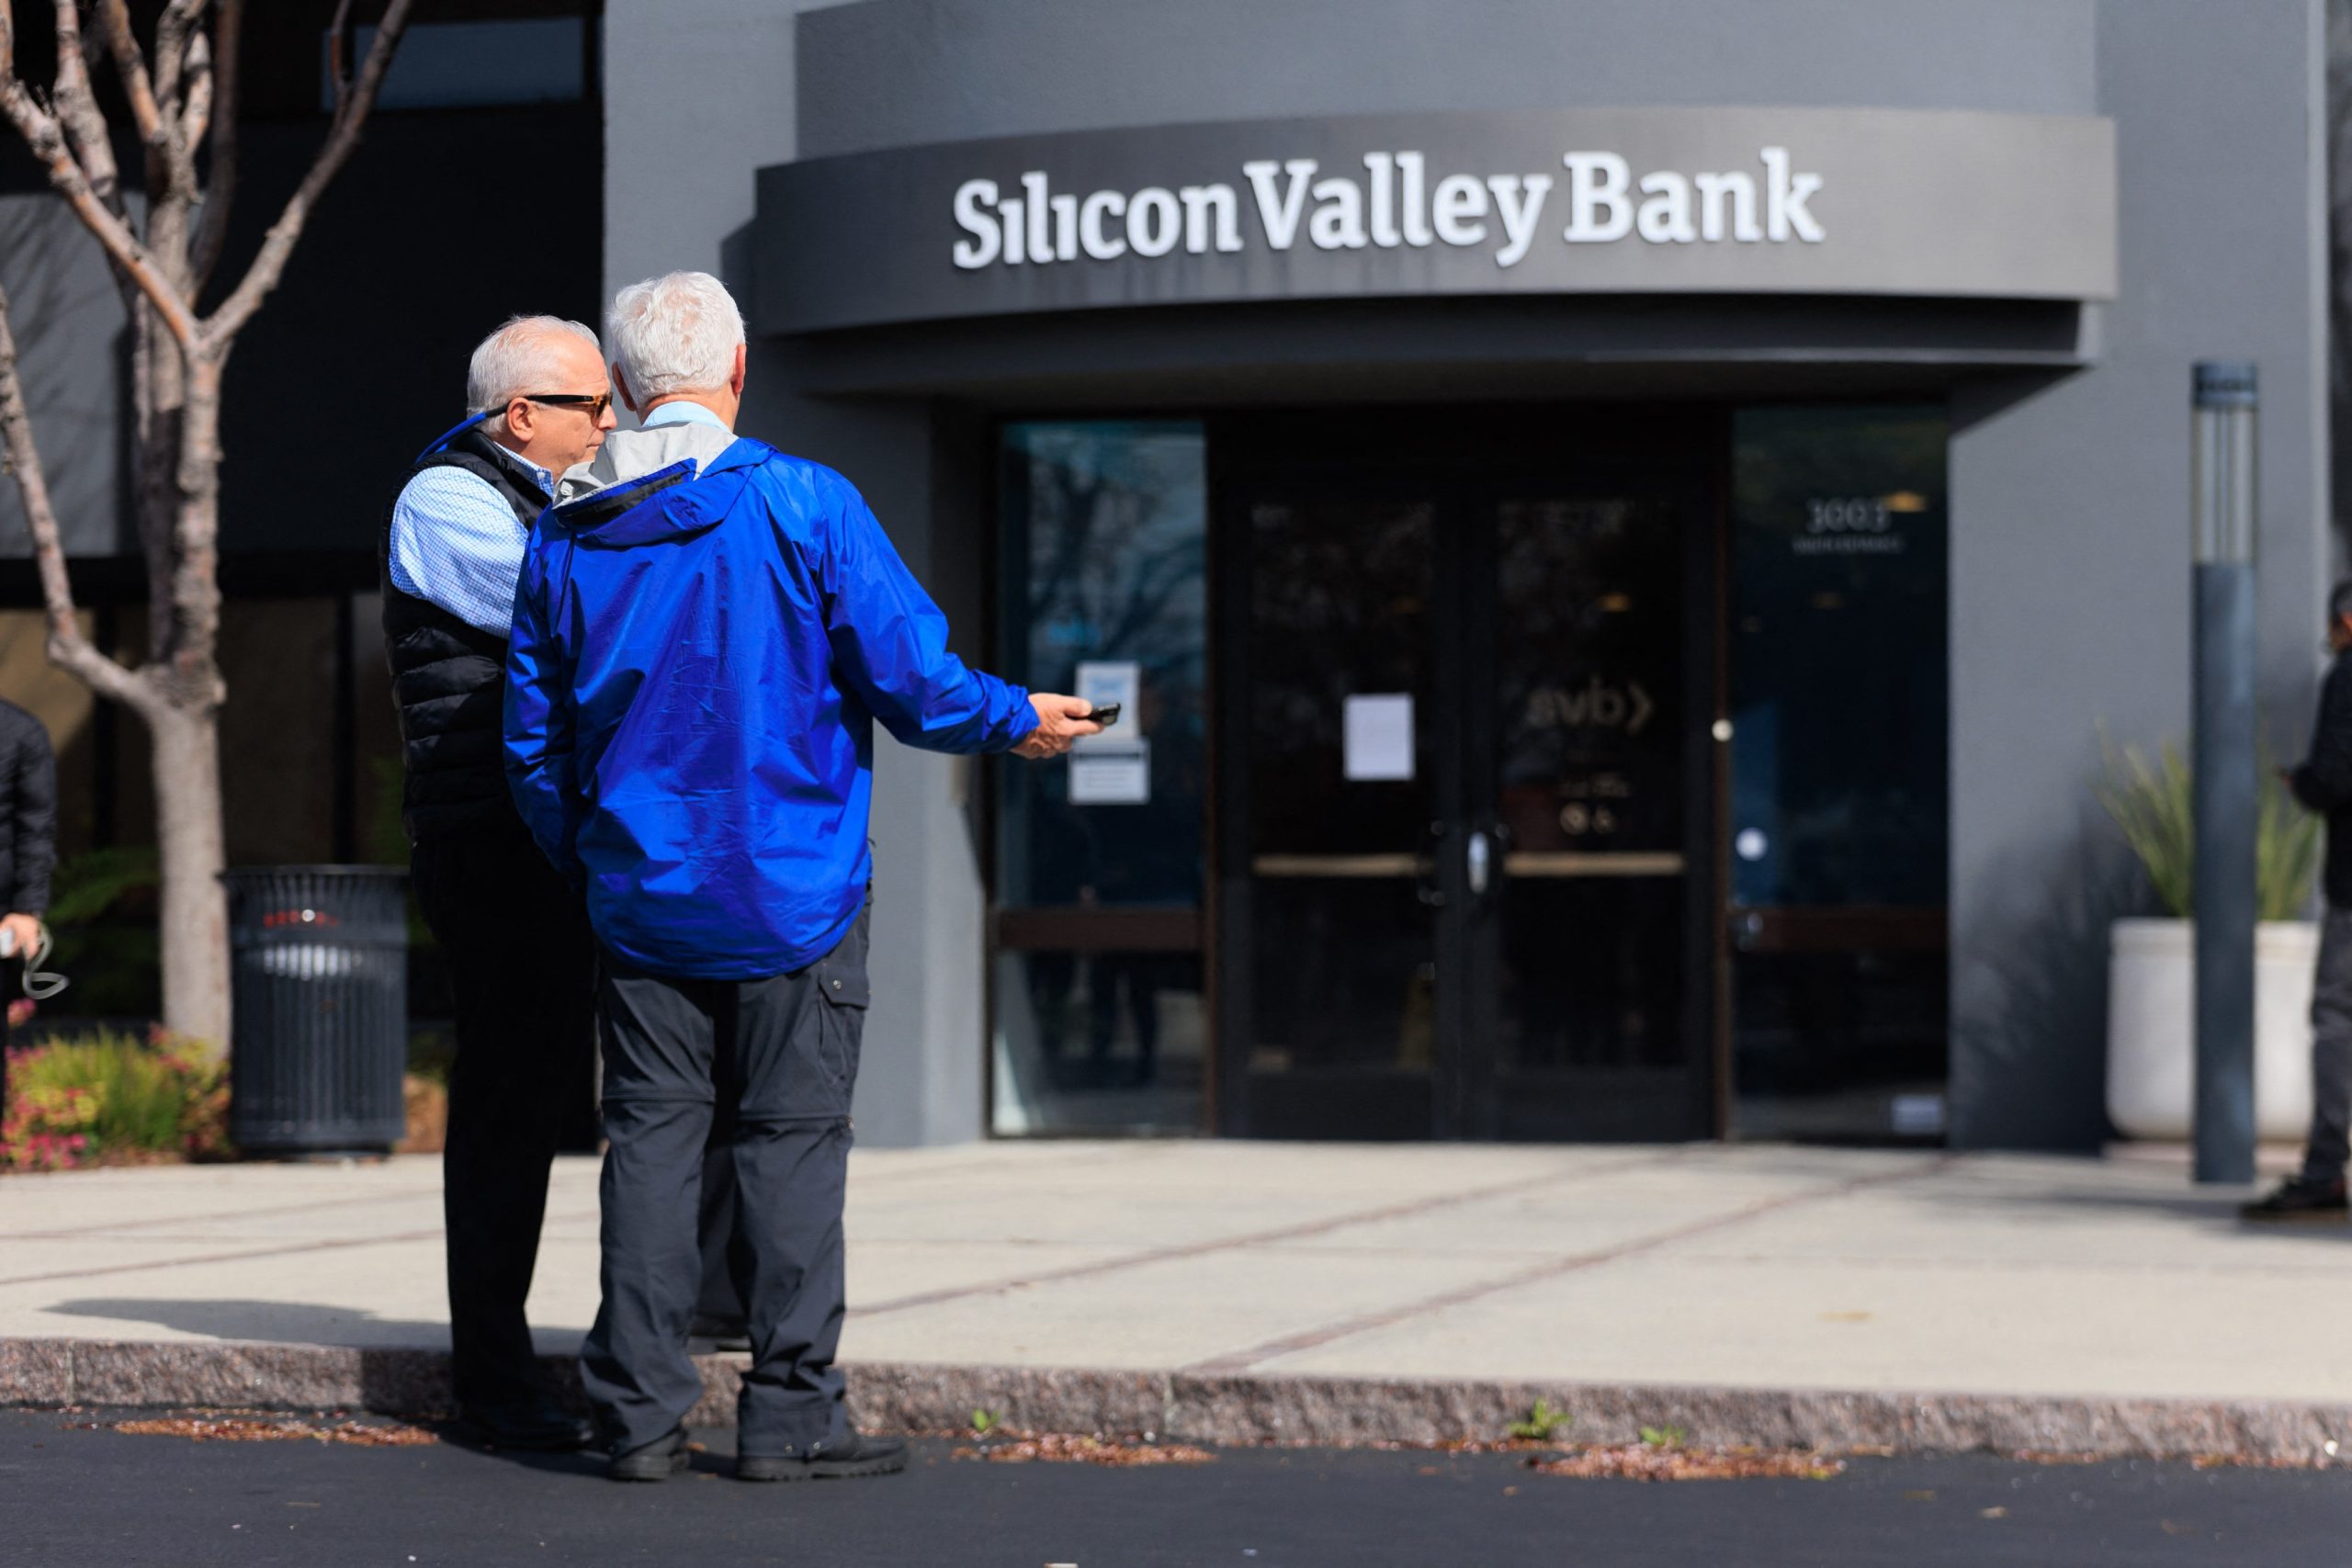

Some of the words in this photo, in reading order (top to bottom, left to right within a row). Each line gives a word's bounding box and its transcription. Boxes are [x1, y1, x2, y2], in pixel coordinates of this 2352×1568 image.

[954, 171, 1242, 269] Silicon
[1242, 150, 1553, 267] Valley
[1563, 145, 1825, 244] Bank
